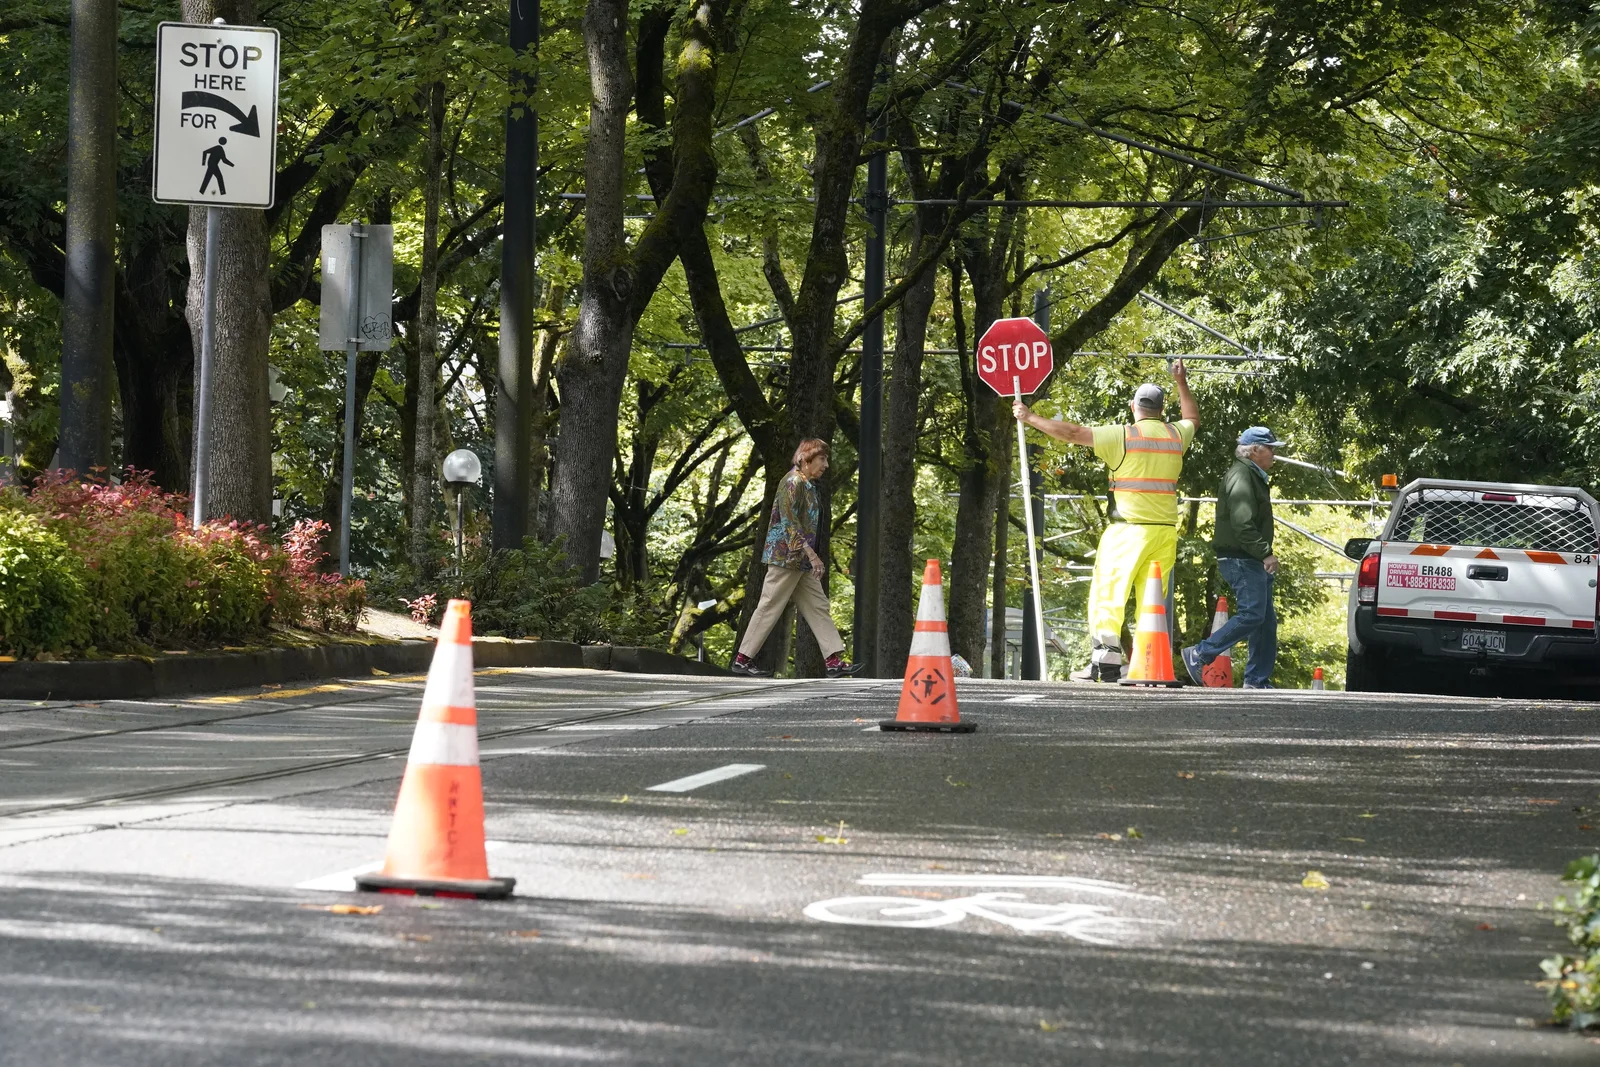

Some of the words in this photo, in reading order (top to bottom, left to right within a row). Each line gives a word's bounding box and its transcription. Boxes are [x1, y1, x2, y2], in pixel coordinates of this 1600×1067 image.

[179, 42, 263, 70] STOP
[194, 73, 246, 91] HERE
[180, 113, 217, 130] FOR
[981, 341, 1048, 373] STOP
[1574, 554, 1591, 565] 84
[1421, 565, 1453, 577] ER488
[1387, 575, 1403, 587] CALL
